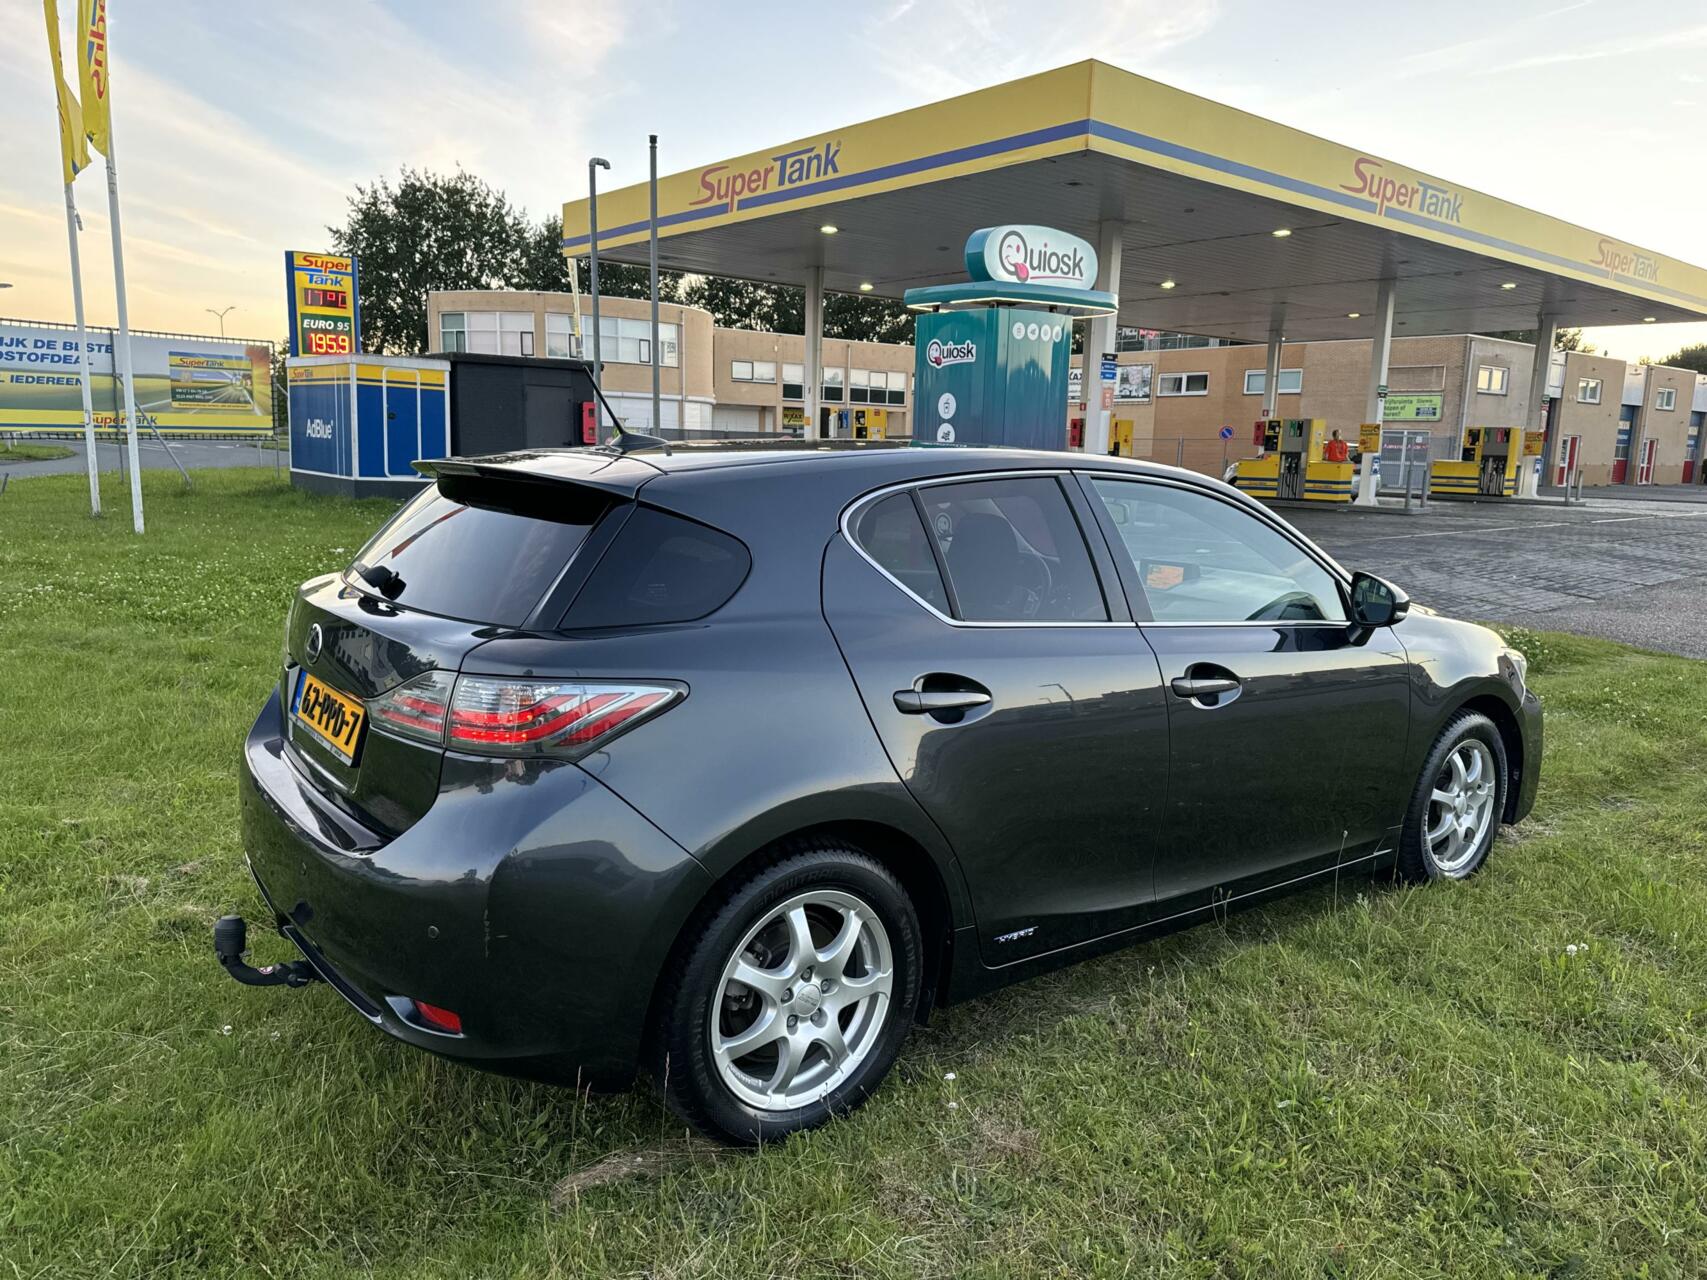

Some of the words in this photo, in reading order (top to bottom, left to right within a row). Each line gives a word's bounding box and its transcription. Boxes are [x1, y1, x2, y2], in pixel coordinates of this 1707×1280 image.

[689, 142, 841, 213] SuperTank
[1339, 157, 1463, 222] SuperTank
[295, 255, 351, 273] Super
[999, 230, 1083, 282] Quiosk
[1590, 238, 1659, 282] SuperTank
[304, 273, 344, 287] Tank
[303, 319, 334, 330] EURO
[337, 322, 350, 331] 95
[33, 339, 57, 350] DE
[928, 341, 974, 366] Quiosk
